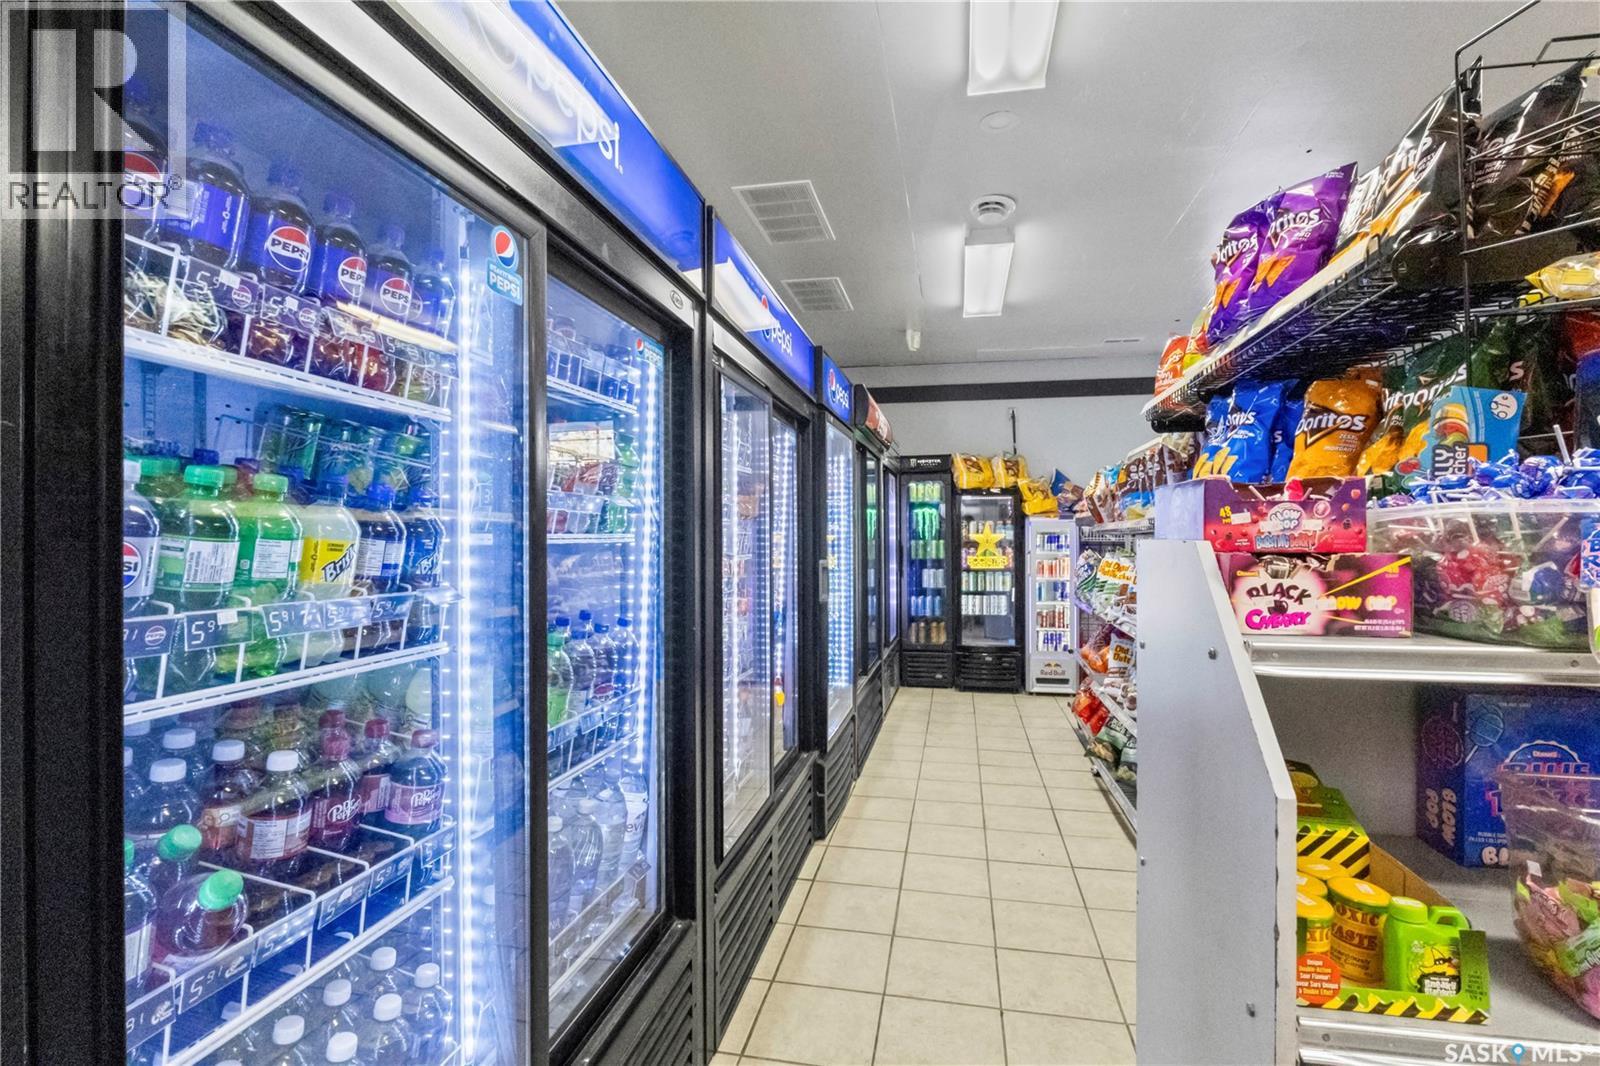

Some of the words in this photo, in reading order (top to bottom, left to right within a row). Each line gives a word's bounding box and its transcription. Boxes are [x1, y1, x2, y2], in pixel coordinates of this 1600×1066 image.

[271, 237, 309, 261] PEPSI
[381, 288, 408, 305] PEPS
[489, 271, 520, 299] PEPSI
[771, 321, 793, 357] pepsi
[835, 383, 850, 409] pepsi
[1295, 413, 1367, 435] Doritos
[1335, 904, 1380, 927] OXIC
